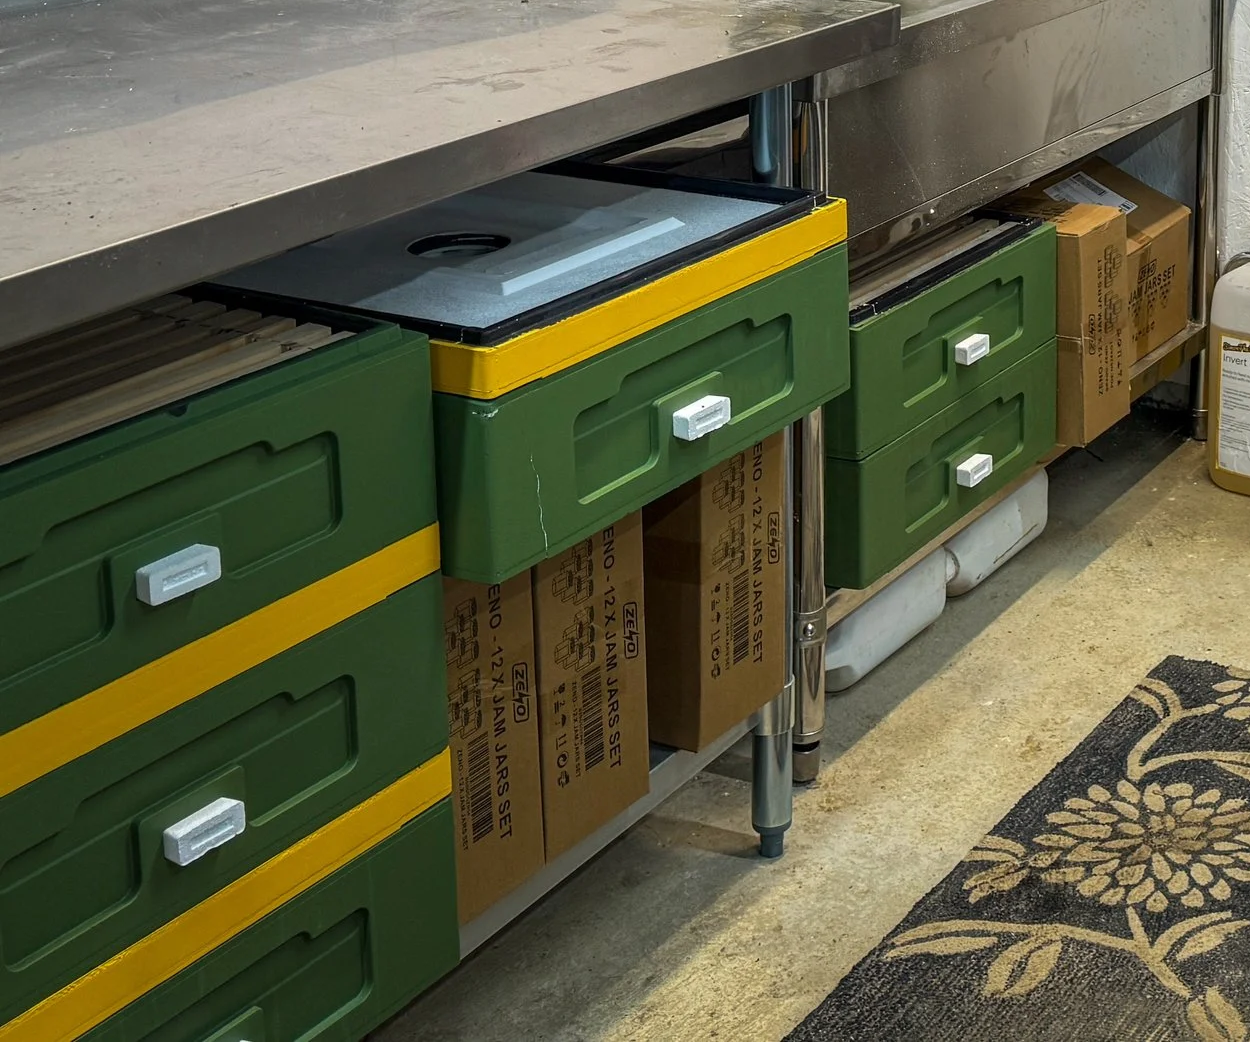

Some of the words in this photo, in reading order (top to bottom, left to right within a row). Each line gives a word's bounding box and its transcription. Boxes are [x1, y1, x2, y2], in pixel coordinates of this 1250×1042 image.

[1144, 273, 1162, 295] JARS
[1162, 263, 1176, 282] SET
[1223, 354, 1247, 366] Invert
[752, 441, 763, 481] ENO
[752, 496, 762, 518] 12
[752, 520, 762, 531] X
[603, 526, 615, 569] ENO
[751, 534, 763, 576] JAM
[488, 584, 502, 630] ENO
[603, 585, 616, 610] 12
[751, 580, 763, 628] JARS
[604, 614, 616, 627] X
[491, 646, 504, 671] 12
[604, 631, 618, 676] JAM
[752, 631, 763, 664] SET
[491, 674, 505, 690] X
[492, 695, 507, 740] JAM
[606, 679, 620, 729] JARS
[494, 742, 510, 798] JARS
[608, 735, 622, 769] SET
[497, 802, 513, 840] SET
